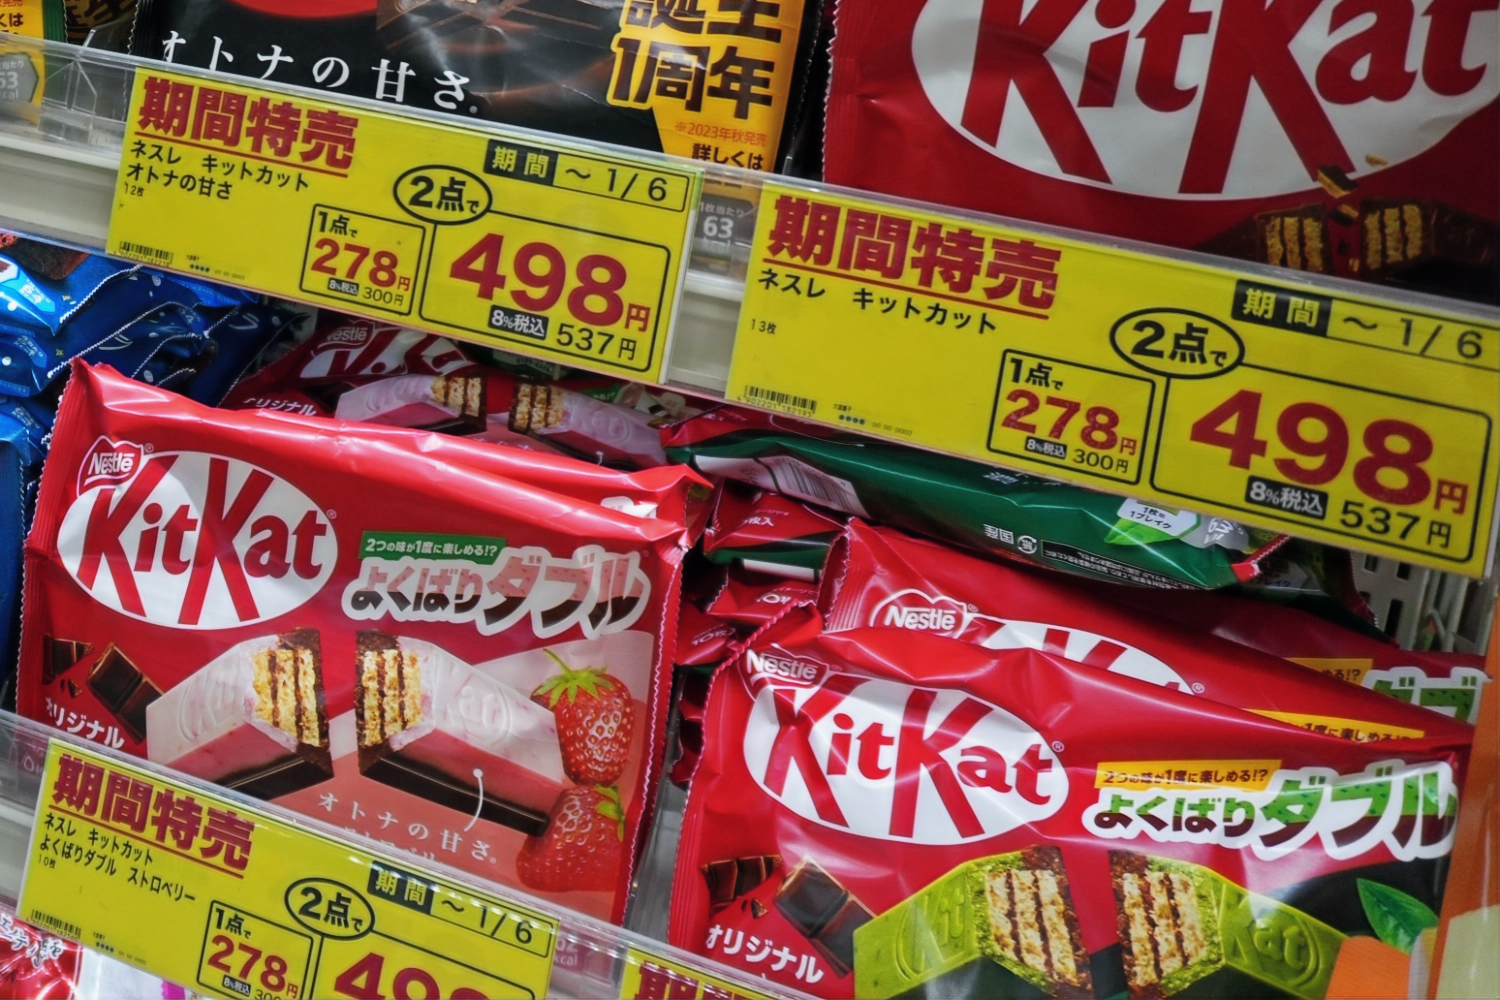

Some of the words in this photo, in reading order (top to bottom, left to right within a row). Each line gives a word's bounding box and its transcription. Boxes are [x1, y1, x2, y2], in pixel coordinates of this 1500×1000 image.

[610, 34, 776, 120] 1周年
[135, 76, 359, 168] 期間特売
[126, 161, 234, 201] オトナの甘さ
[128, 140, 183, 165] ネスレ
[198, 153, 311, 193] キットカット
[492, 147, 545, 180] 期間
[692, 143, 764, 170] 詳しくは
[408, 174, 481, 215] 2点で
[767, 192, 1063, 311] 期間特売
[756, 267, 828, 300] ネスレ
[851, 286, 998, 336] キットカット
[1241, 287, 1320, 328] 期間
[1129, 316, 1228, 370] 2点で
[88, 451, 134, 477] Nestlé
[74, 453, 329, 627] KitKat
[887, 602, 956, 632] Nestlé
[747, 653, 817, 682] Nestlé
[760, 689, 1055, 840] KitKat
[44, 811, 78, 841] ネスレ
[87, 826, 154, 865] キットカット
[52, 752, 258, 875] 期間特売
[38, 839, 118, 882] よくばりダブル
[126, 867, 197, 906] ストロベリー
[705, 921, 825, 986] オリジナル
